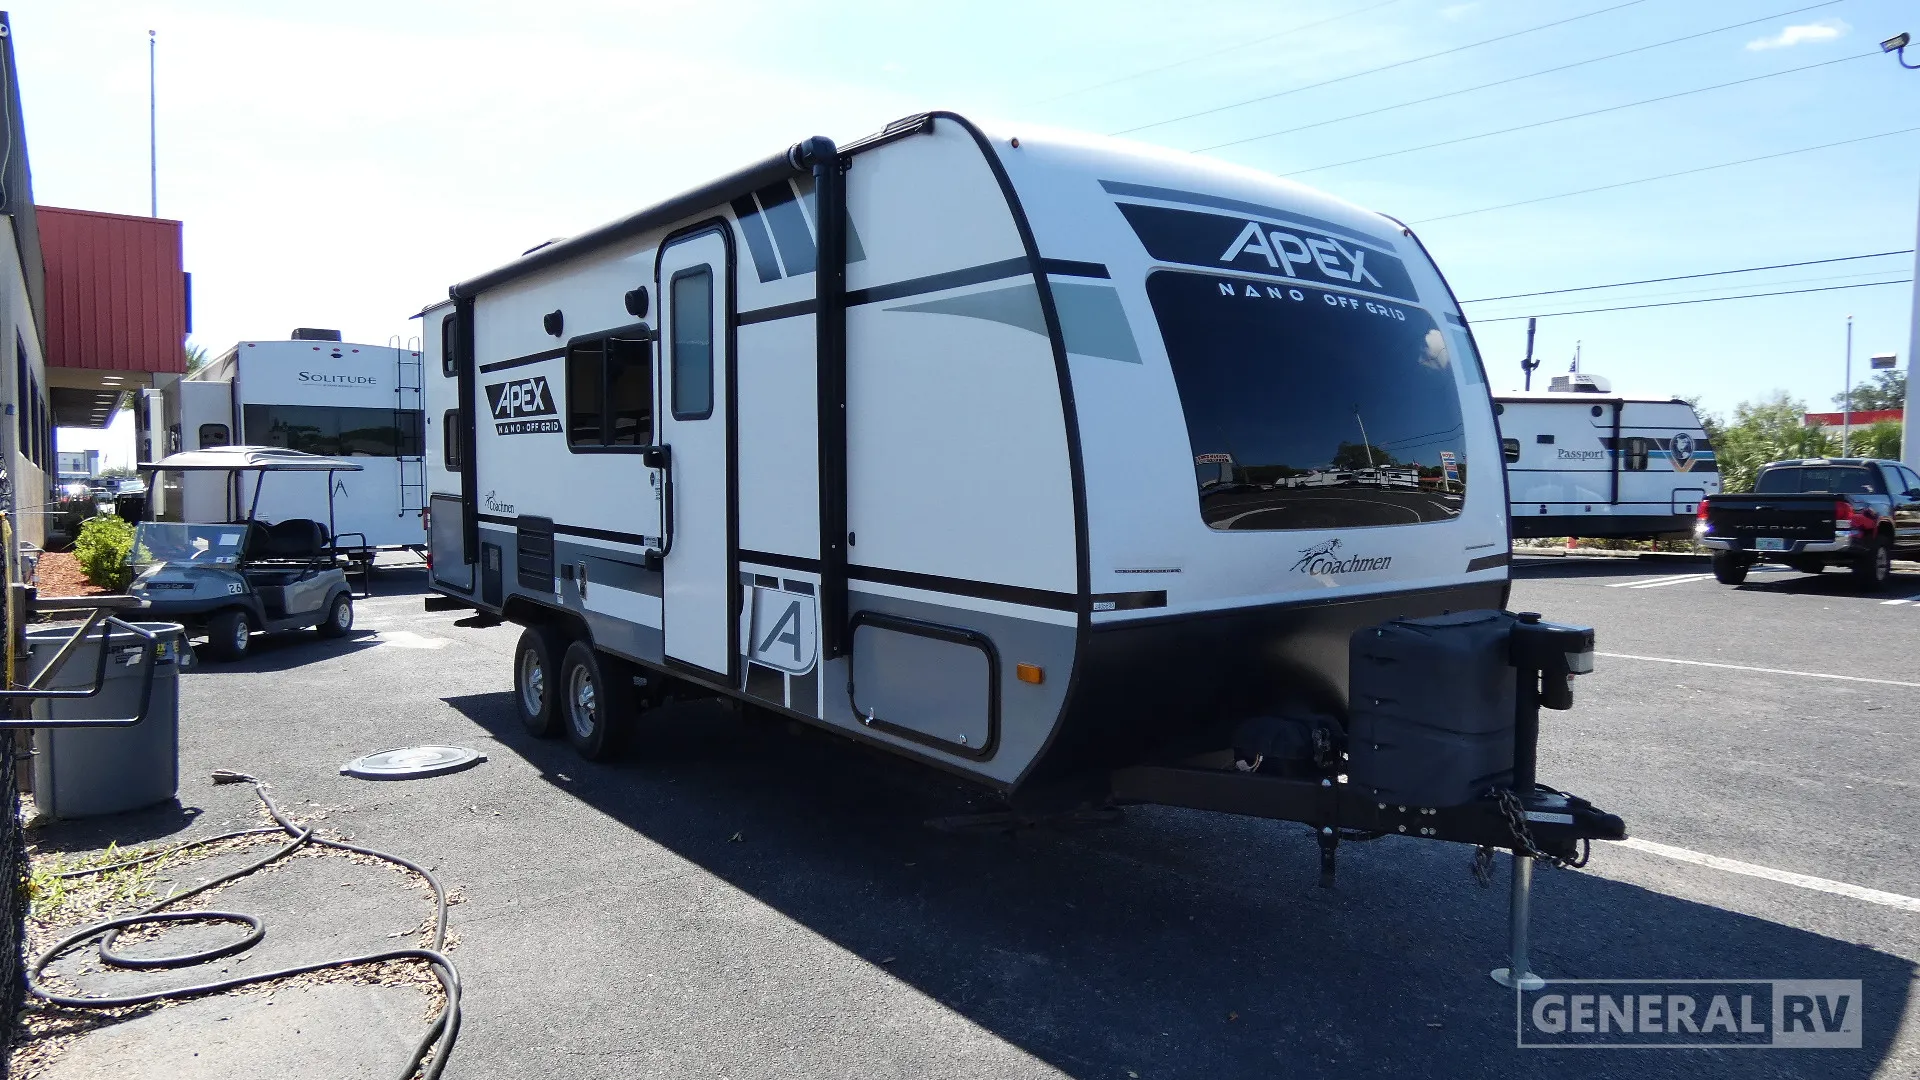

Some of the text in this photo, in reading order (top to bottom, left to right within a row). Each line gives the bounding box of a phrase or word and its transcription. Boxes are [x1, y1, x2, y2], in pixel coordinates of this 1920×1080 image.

[1219, 221, 1383, 289] APEX
[1218, 282, 1406, 322] NANO OFF GRID
[298, 371, 377, 385] SOLITUDE
[494, 378, 545, 418] APEX
[498, 421, 559, 434] NANO OFF GRID
[1557, 448, 1604, 461] Passport
[1309, 553, 1392, 576] Coachmen
[229, 584, 242, 593] 26
[758, 600, 802, 663] A
